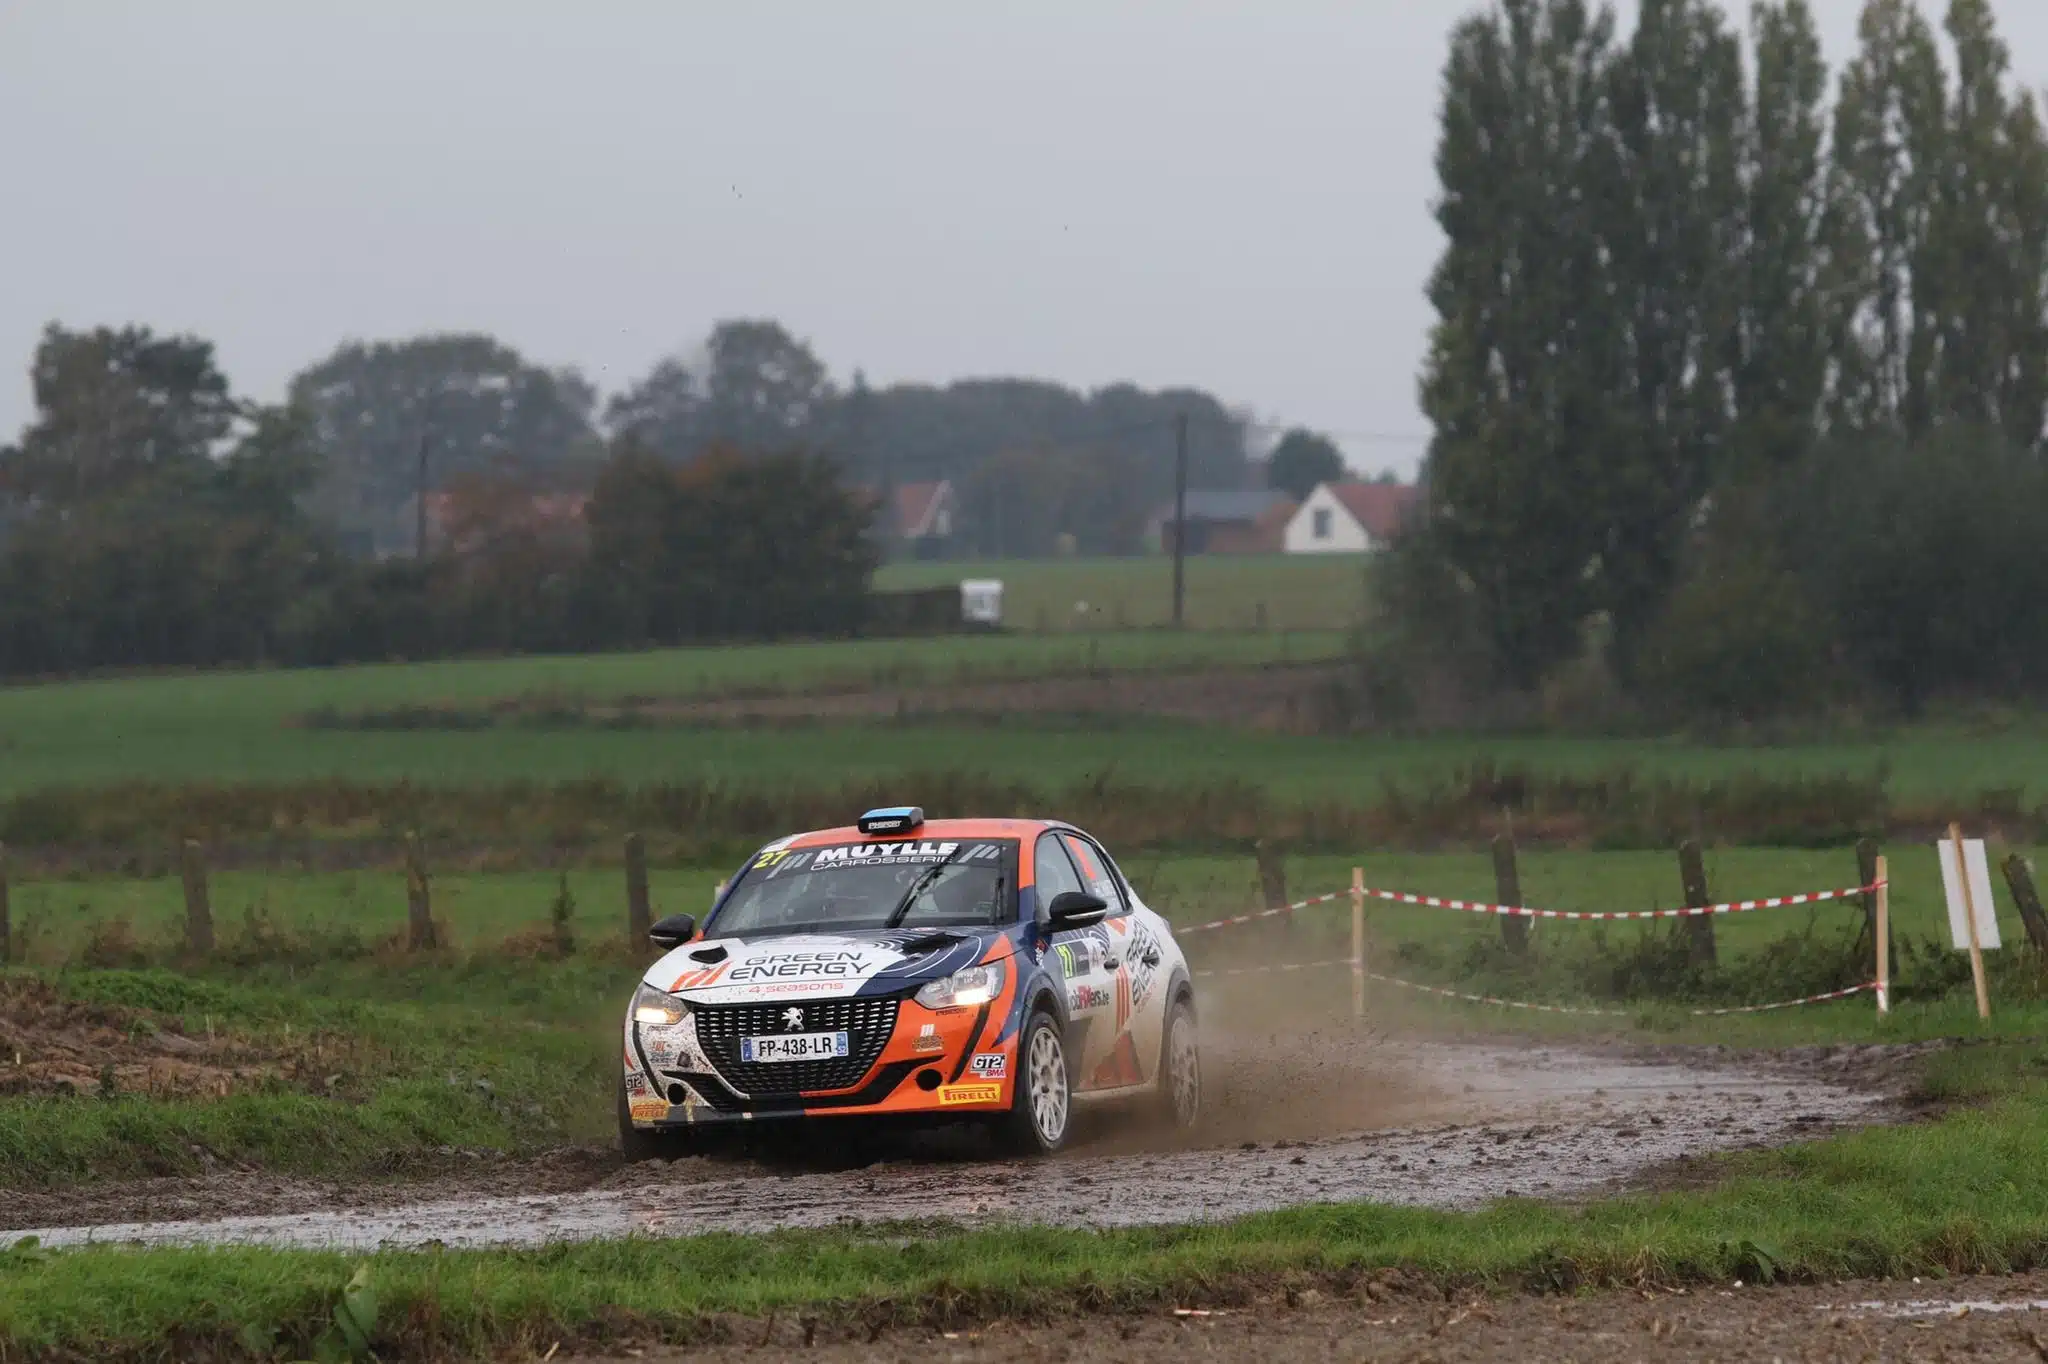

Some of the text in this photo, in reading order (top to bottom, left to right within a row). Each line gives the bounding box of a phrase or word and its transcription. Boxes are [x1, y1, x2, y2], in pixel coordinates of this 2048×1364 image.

[752, 850, 791, 870] 27
[815, 842, 959, 862] MUYLLE
[811, 855, 954, 871] CARROSSERIE
[743, 952, 862, 967] GREEN
[1055, 944, 1073, 979] 27
[729, 961, 873, 981] ENERGY
[748, 983, 844, 993] 4 seasons
[758, 1037, 832, 1056] FP-438-LR
[972, 1054, 1005, 1069] GT2i
[985, 1069, 1004, 1077] BMA
[943, 1086, 997, 1101] PIRELLI
